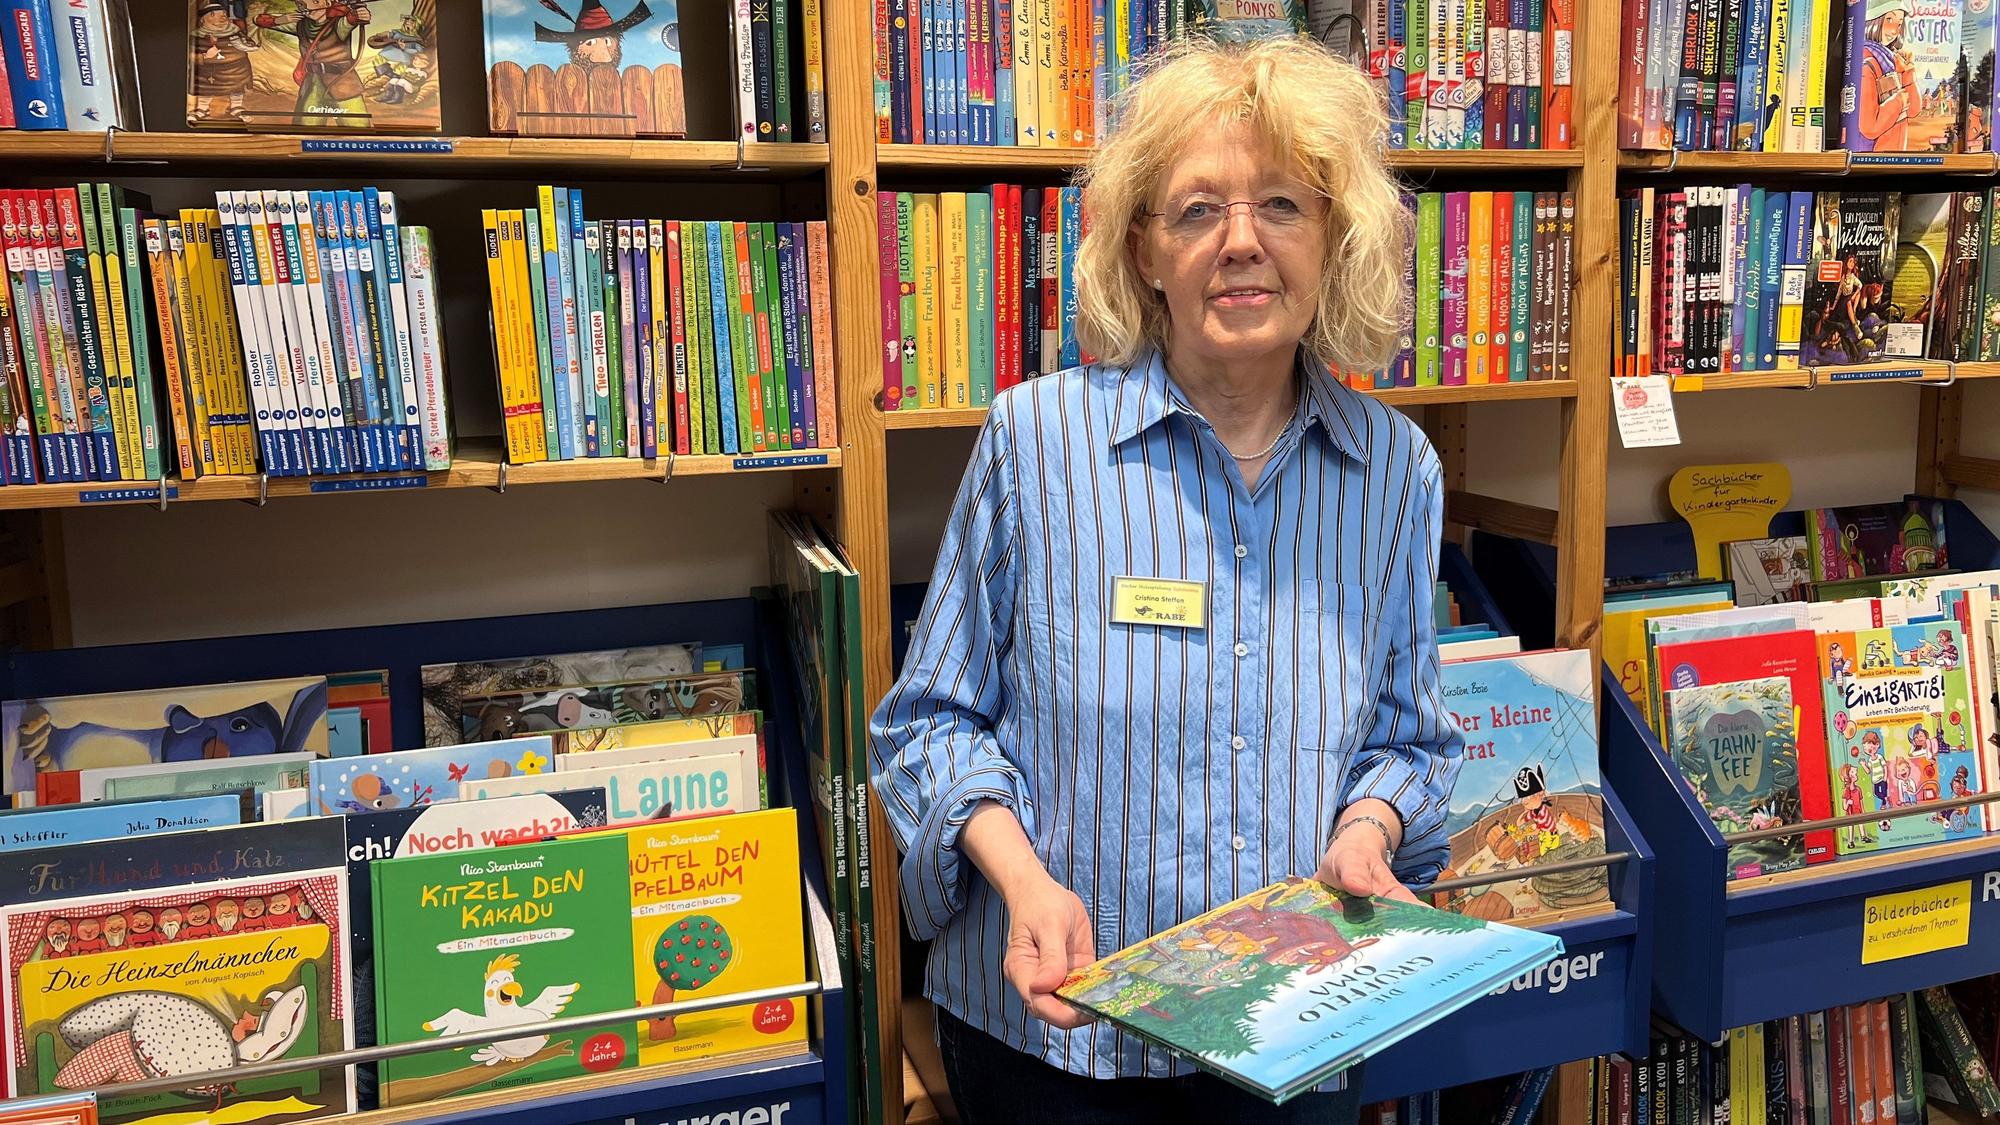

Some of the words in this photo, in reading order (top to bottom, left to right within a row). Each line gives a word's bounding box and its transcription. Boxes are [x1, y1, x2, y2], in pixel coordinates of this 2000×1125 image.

[776, 6, 784, 24] DER
[1236, 0, 1276, 18] PONYS
[1908, 0, 1956, 18] Seaside
[808, 40, 820, 66] Neues
[1020, 41, 1030, 65] Emmi
[1416, 32, 1424, 47] DIE
[1685, 12, 1698, 69] SHERLOCK
[1704, 20, 1716, 76] SHERLOCK
[1725, 20, 1737, 76] SHERLOCK
[1040, 44, 1051, 68] Emmi
[1059, 69, 1068, 90] Bella
[1046, 205, 1057, 274] Ahoibande
[1643, 218, 1652, 237] SONG
[1829, 208, 1885, 250] Willow
[226, 228, 242, 280] ERSTLESER
[242, 229, 258, 281] ERSTLESER
[255, 230, 271, 281] ERSTLESER
[272, 228, 288, 278] ERSTLESER
[286, 229, 302, 280] ERSTLESER
[302, 228, 318, 278] ERSTLESER
[488, 233, 498, 258] DUDEN
[998, 208, 1008, 307] Schurkenschnapp-AG
[1520, 242, 1528, 277] TALENTS
[1642, 238, 1651, 266] LUNAS
[1430, 246, 1439, 282] TALENTS
[1458, 244, 1466, 280] TALENTS
[1480, 242, 1489, 278] TALENTS
[1502, 243, 1510, 280] TALENTS
[1536, 250, 1544, 280] Mähne!
[1026, 270, 1036, 289] Max
[1430, 284, 1437, 294] OF
[1458, 282, 1465, 295] OF
[1479, 280, 1487, 292] OF
[1500, 280, 1508, 292] OF
[1520, 278, 1527, 290] OF
[1429, 296, 1437, 328] SCHOOL
[1456, 296, 1464, 328] SCHOOL
[1478, 294, 1486, 326] SCHOOL
[1499, 294, 1508, 327] SCHOOL
[1518, 292, 1526, 325] SCHOOL
[250, 349, 262, 387] Roboter
[278, 354, 289, 386] Ozeane
[294, 347, 305, 385] Vulkane
[322, 340, 334, 384] Weltraum
[400, 330, 412, 382] Dinosaurier
[676, 344, 684, 375] EINSTEIN
[264, 354, 276, 387] Fußball
[308, 355, 320, 386] Pferde
[422, 352, 438, 411] Pferdeabenteuer
[428, 412, 440, 437] Starke
[241, 432, 252, 466] Leseprofi
[510, 424, 518, 457] Leseprofi
[8, 438, 18, 476] Ravensburger
[21, 439, 31, 478] Ravensburger
[44, 438, 55, 476] Ravensburger
[58, 436, 70, 474] Ravensburger
[1692, 472, 1764, 487] Sachbücher
[1683, 496, 1778, 513] Kindergartenkinder
[1156, 612, 1186, 621] RABE
[1471, 682, 1488, 694] Boie
[1450, 712, 1481, 732] Der
[1491, 704, 1552, 729] kleine
[1894, 704, 1931, 713] Behinderung
[1718, 724, 1729, 734] Die
[1709, 734, 1761, 761] ZAHN-
[1721, 757, 1753, 781] FEE
[212, 782, 226, 792] Ralf
[610, 770, 729, 818] Laune
[125, 818, 150, 836] Julia
[154, 816, 210, 831] Donaldson
[834, 774, 845, 858] Riesenbilderbuch
[857, 782, 869, 871] Riesenbilderbuch
[12, 830, 68, 844] Scheffler
[408, 832, 474, 855] Noch
[481, 816, 570, 846] wach?!
[646, 836, 668, 848] Nico
[670, 830, 719, 846] Sternbaum
[460, 862, 484, 876] Nico
[486, 856, 542, 874] Sternbaum
[836, 860, 846, 878] Das
[860, 872, 870, 890] Das
[640, 905, 655, 916] Ein
[658, 894, 728, 913] Mitmachbuch
[1866, 896, 1958, 924] Bilderbücher
[457, 940, 476, 951] Ein
[479, 929, 558, 948] Mitmachbuch
[1868, 935, 1878, 943] zu
[1882, 922, 1928, 939] verschiedenen
[1930, 918, 1958, 932] Themen
[40, 966, 92, 994] Die
[96, 936, 300, 988] Heinzelmännchen
[184, 978, 198, 986] von
[201, 974, 232, 988] August
[233, 968, 266, 982] Kopisch
[1309, 965, 1377, 996] OMA
[760, 1012, 788, 1026] Jahre
[762, 1004, 782, 1016] 2-4
[1900, 1006, 1908, 1033] WALE
[588, 1050, 617, 1064] Jahre
[592, 1041, 612, 1052] 2-4
[674, 1041, 714, 1053] Bassermann
[490, 1075, 534, 1088] Bassermann
